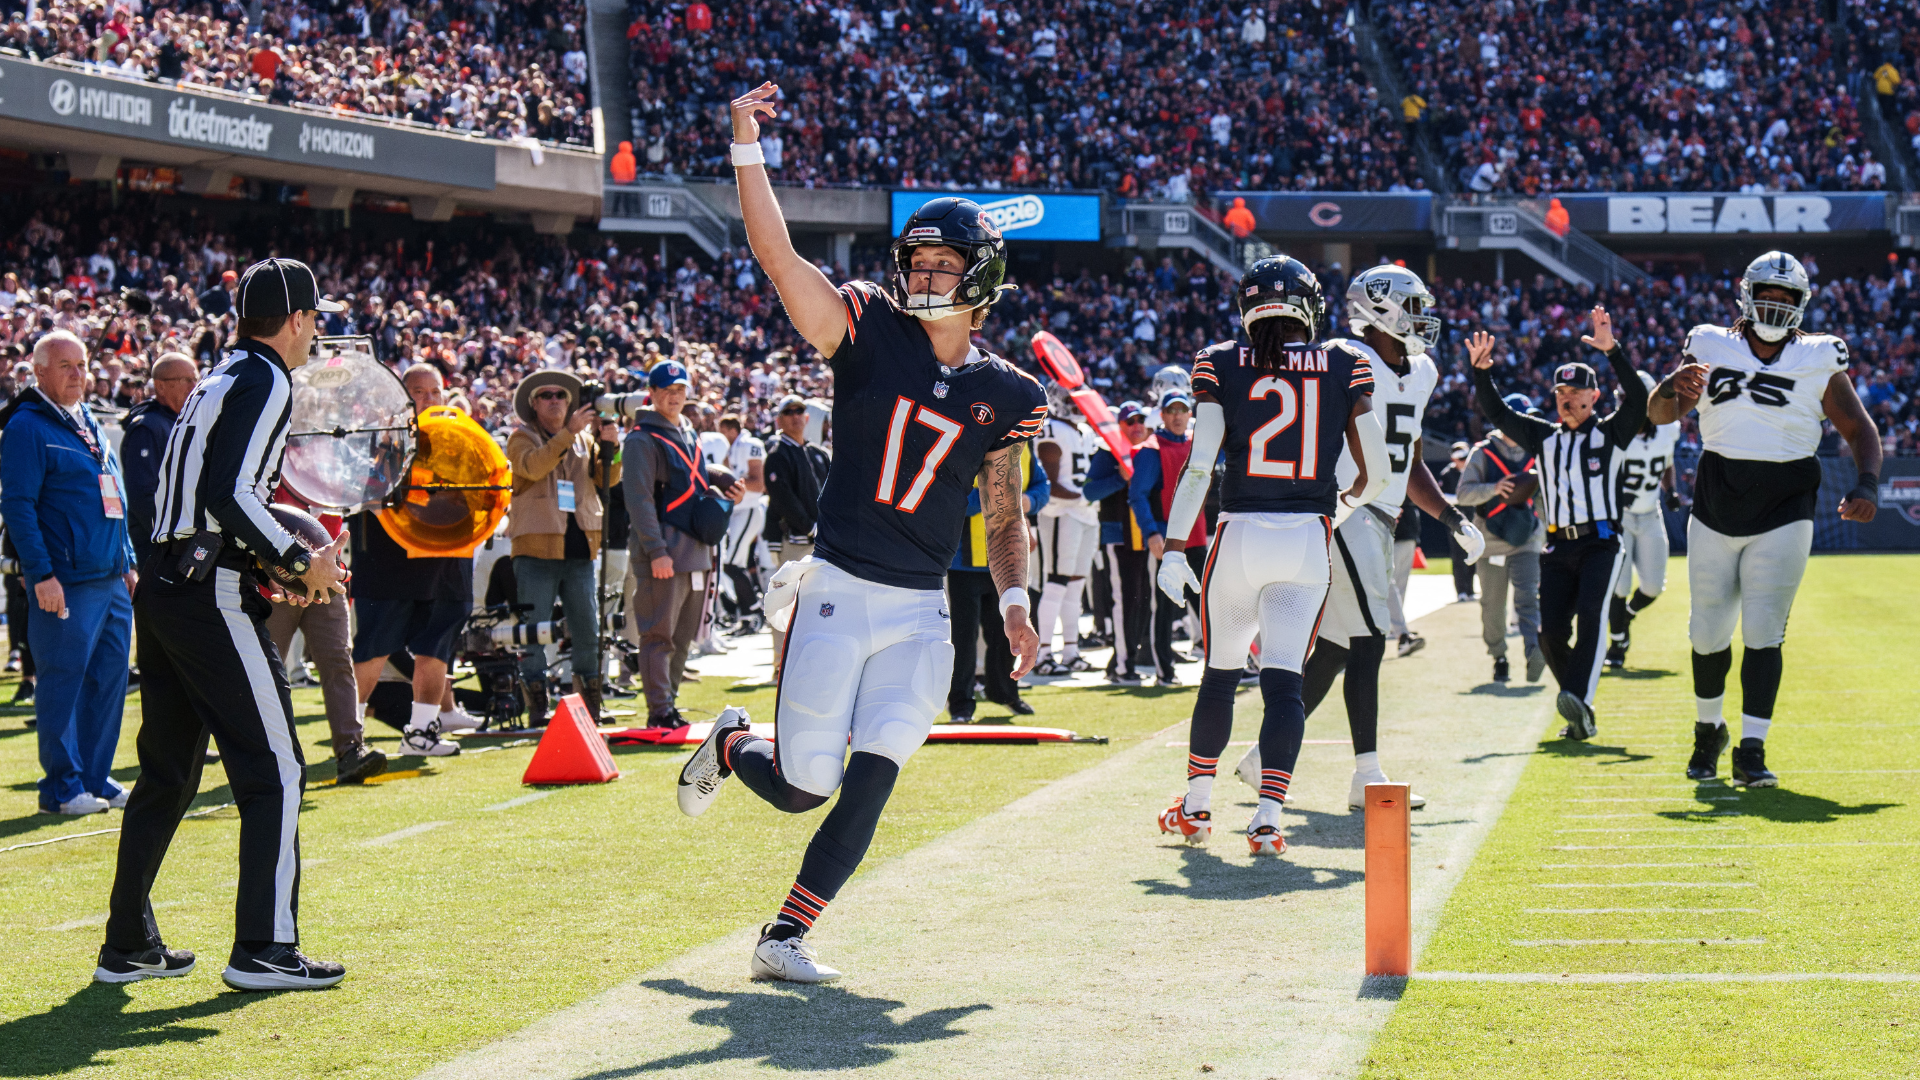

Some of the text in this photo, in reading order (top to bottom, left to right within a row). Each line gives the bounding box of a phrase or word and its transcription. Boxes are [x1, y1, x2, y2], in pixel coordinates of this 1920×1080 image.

[80, 87, 151, 126] HYUNDAI
[168, 98, 273, 151] ticketmaster
[311, 126, 374, 160] HORIZON
[1608, 196, 1831, 233] BEAR
[1255, 304, 1284, 314] BEARS
[1239, 346, 1329, 373] FMAN
[977, 409, 988, 423] 51
[1247, 374, 1320, 480] 21
[875, 395, 965, 514] 17
[1623, 456, 1666, 491] 69
